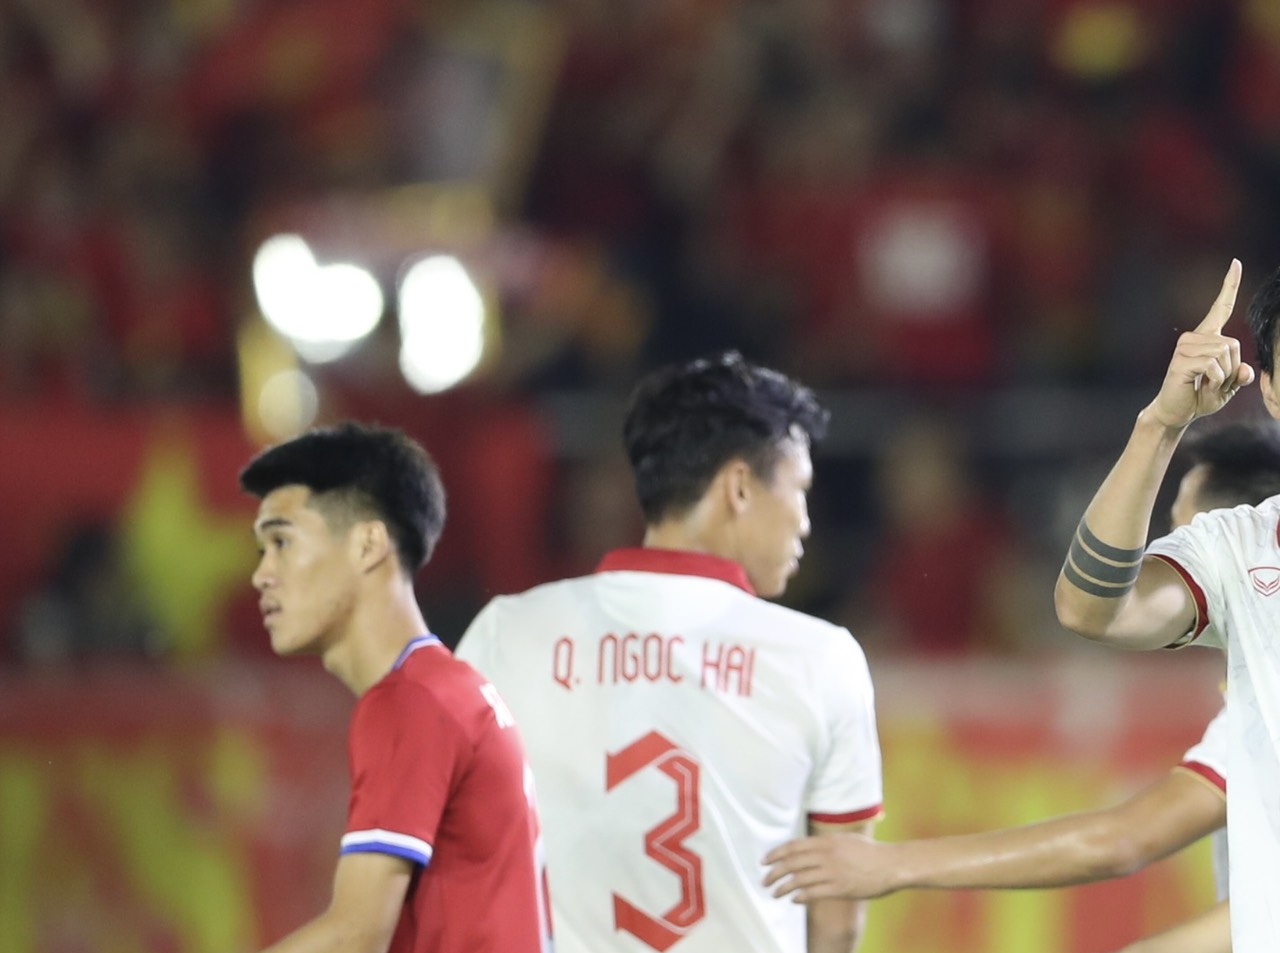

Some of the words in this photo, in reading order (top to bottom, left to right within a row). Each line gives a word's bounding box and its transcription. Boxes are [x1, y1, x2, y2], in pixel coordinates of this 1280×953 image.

[552, 635, 581, 691] Q.
[597, 630, 685, 686] NGOC
[699, 639, 757, 698] HAI
[605, 729, 706, 953] 3
